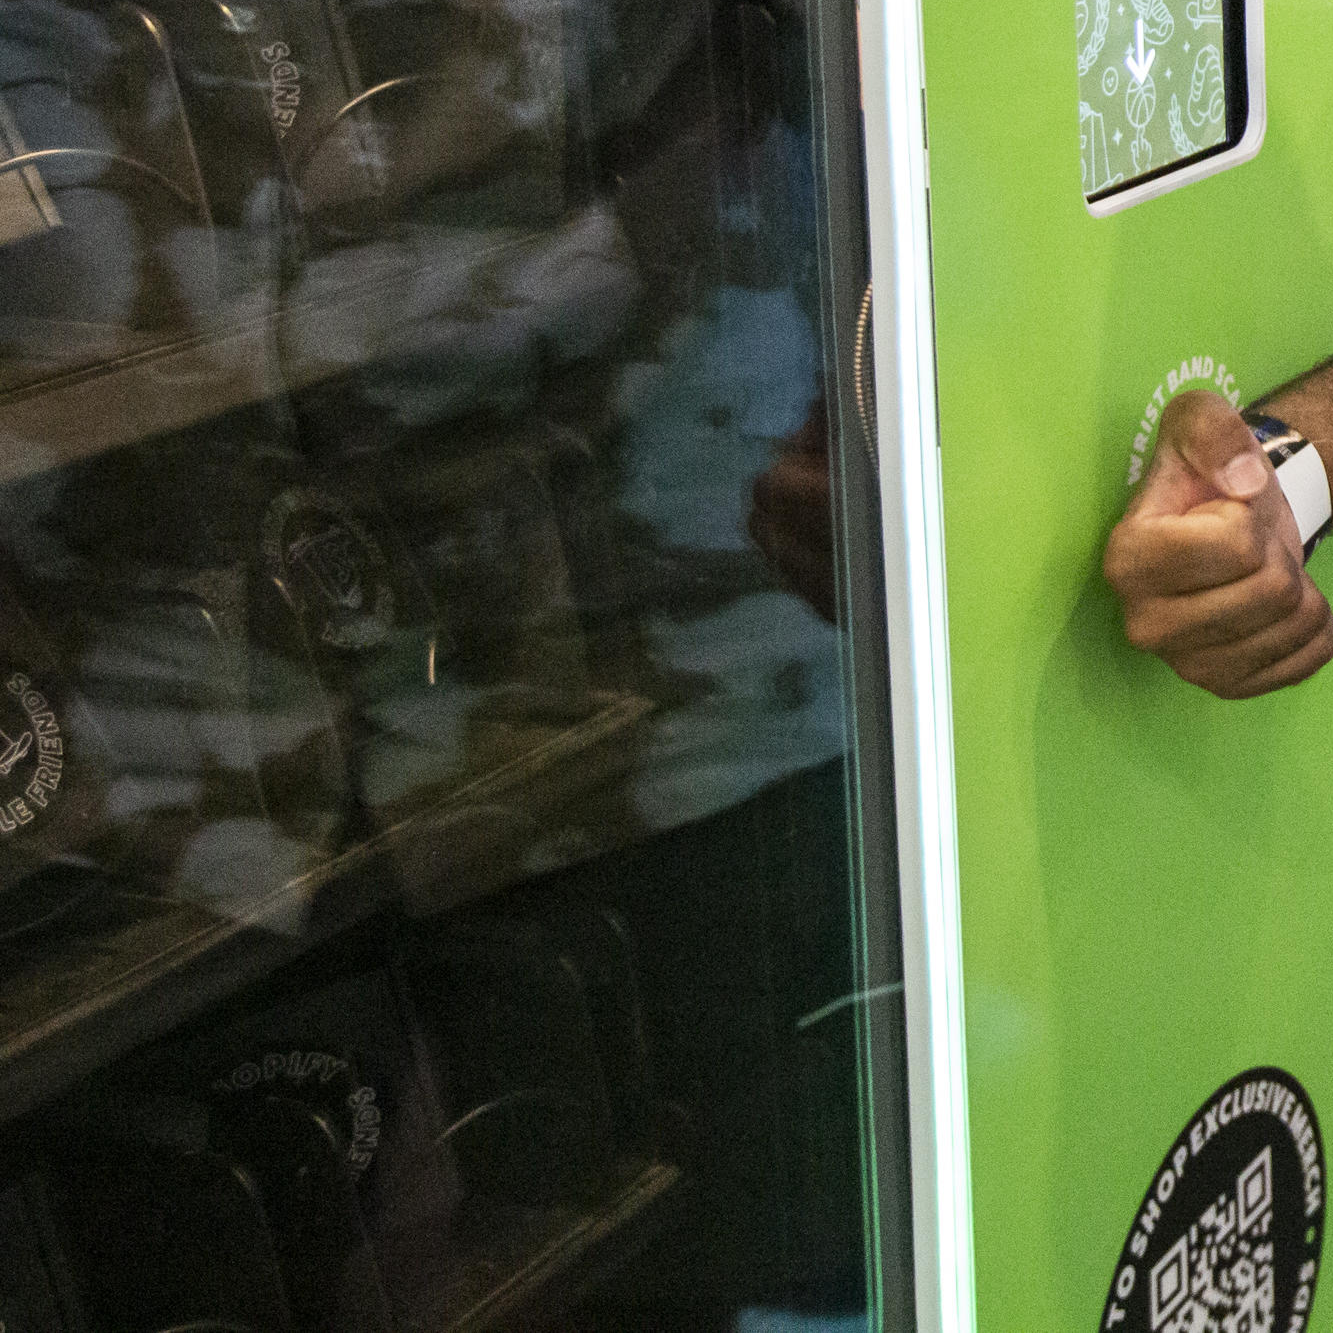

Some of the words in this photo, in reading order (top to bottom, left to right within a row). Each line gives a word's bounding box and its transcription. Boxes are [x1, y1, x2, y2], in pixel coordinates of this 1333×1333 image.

[1127, 384, 1166, 486] WRIST
[1167, 355, 1215, 393] BAND
[1214, 363, 1245, 412] SCA
[6, 672, 64, 808] FRIENDS
[1105, 1263, 1136, 1330] TO
[1130, 1145, 1189, 1259] SHOP
[1189, 1079, 1298, 1157] EXCLUSIVE
[1290, 1102, 1322, 1217] MERCH
